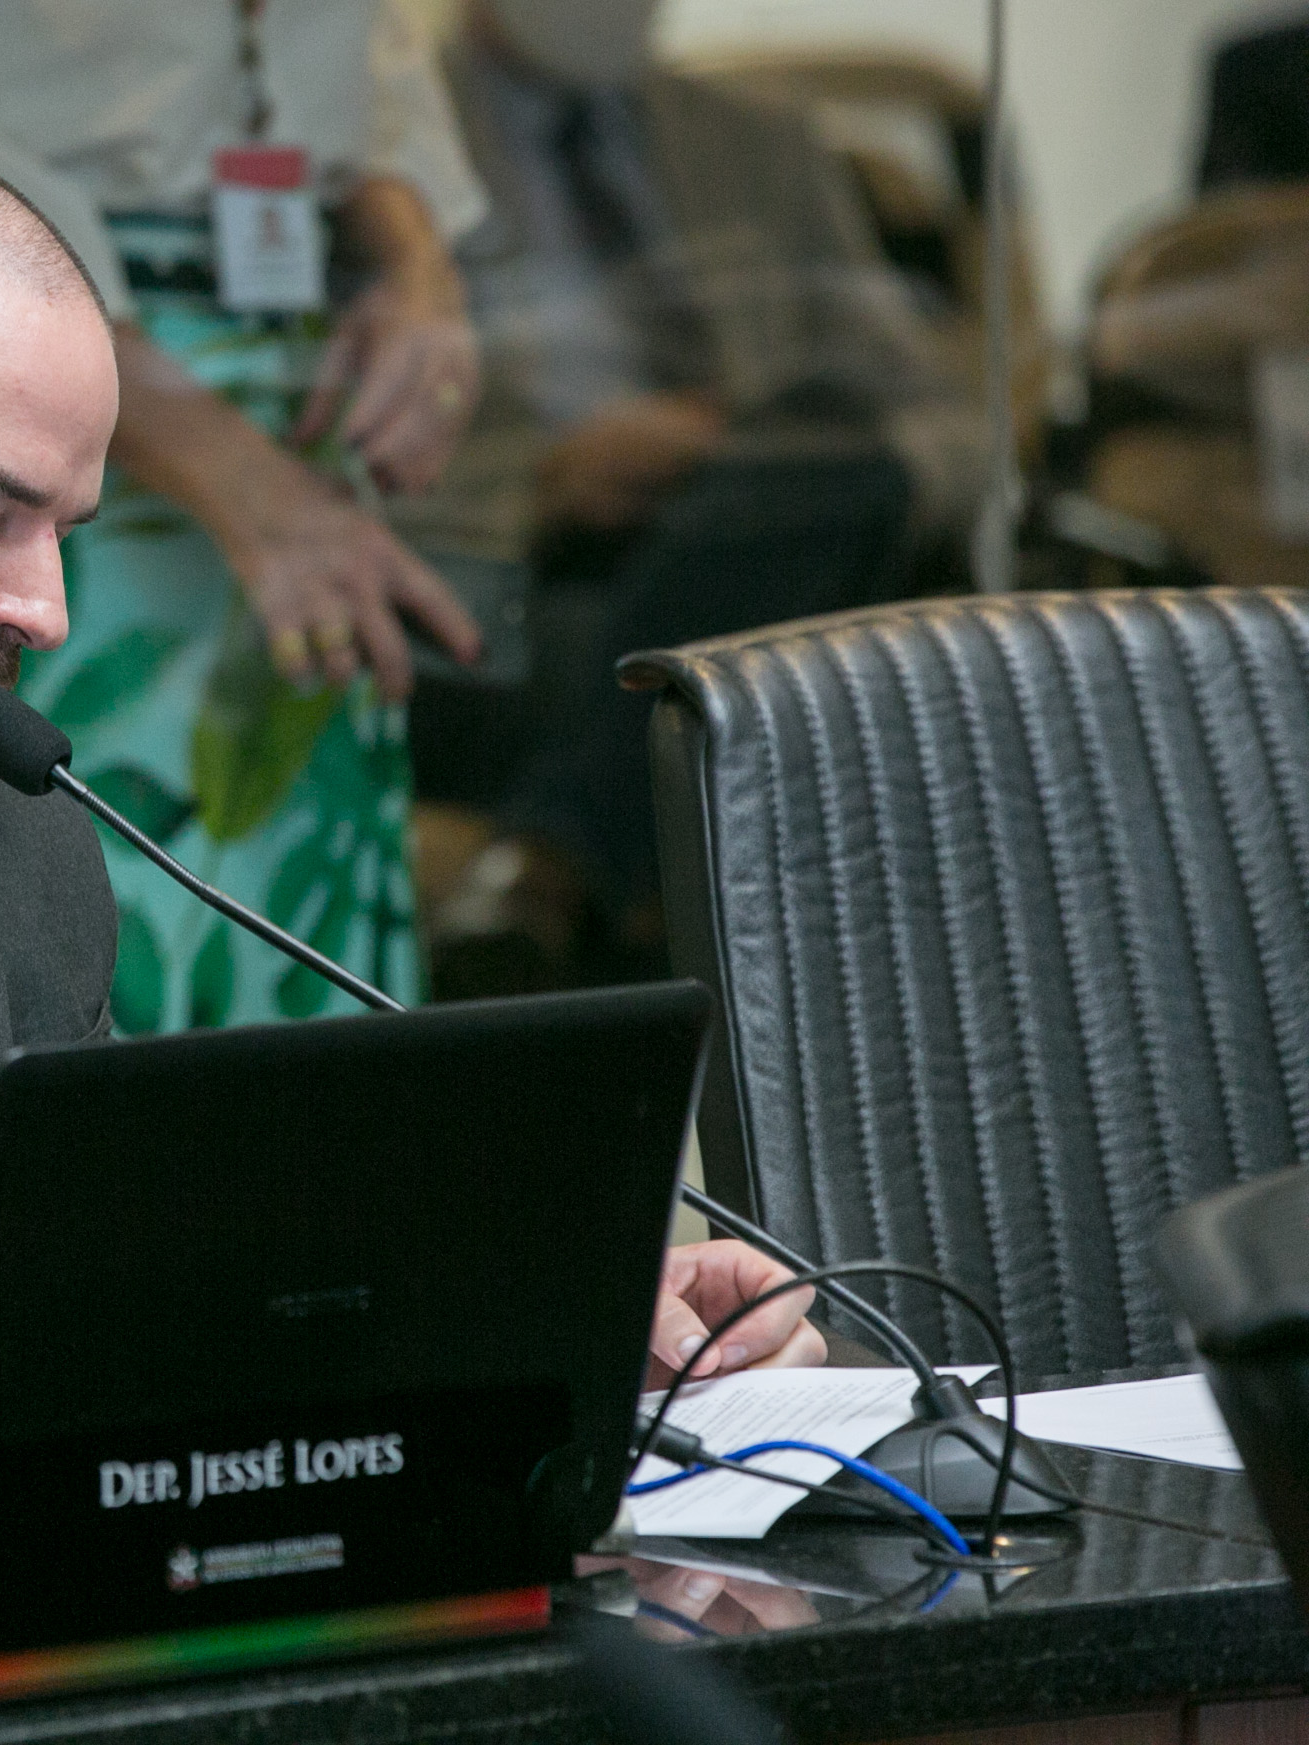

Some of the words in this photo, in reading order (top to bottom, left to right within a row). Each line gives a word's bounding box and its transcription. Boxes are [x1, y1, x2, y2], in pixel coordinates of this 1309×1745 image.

[99, 1460, 181, 1508] DEP.
[189, 1439, 285, 1508] JESSÉ
[294, 1432, 404, 1484] LOPES
